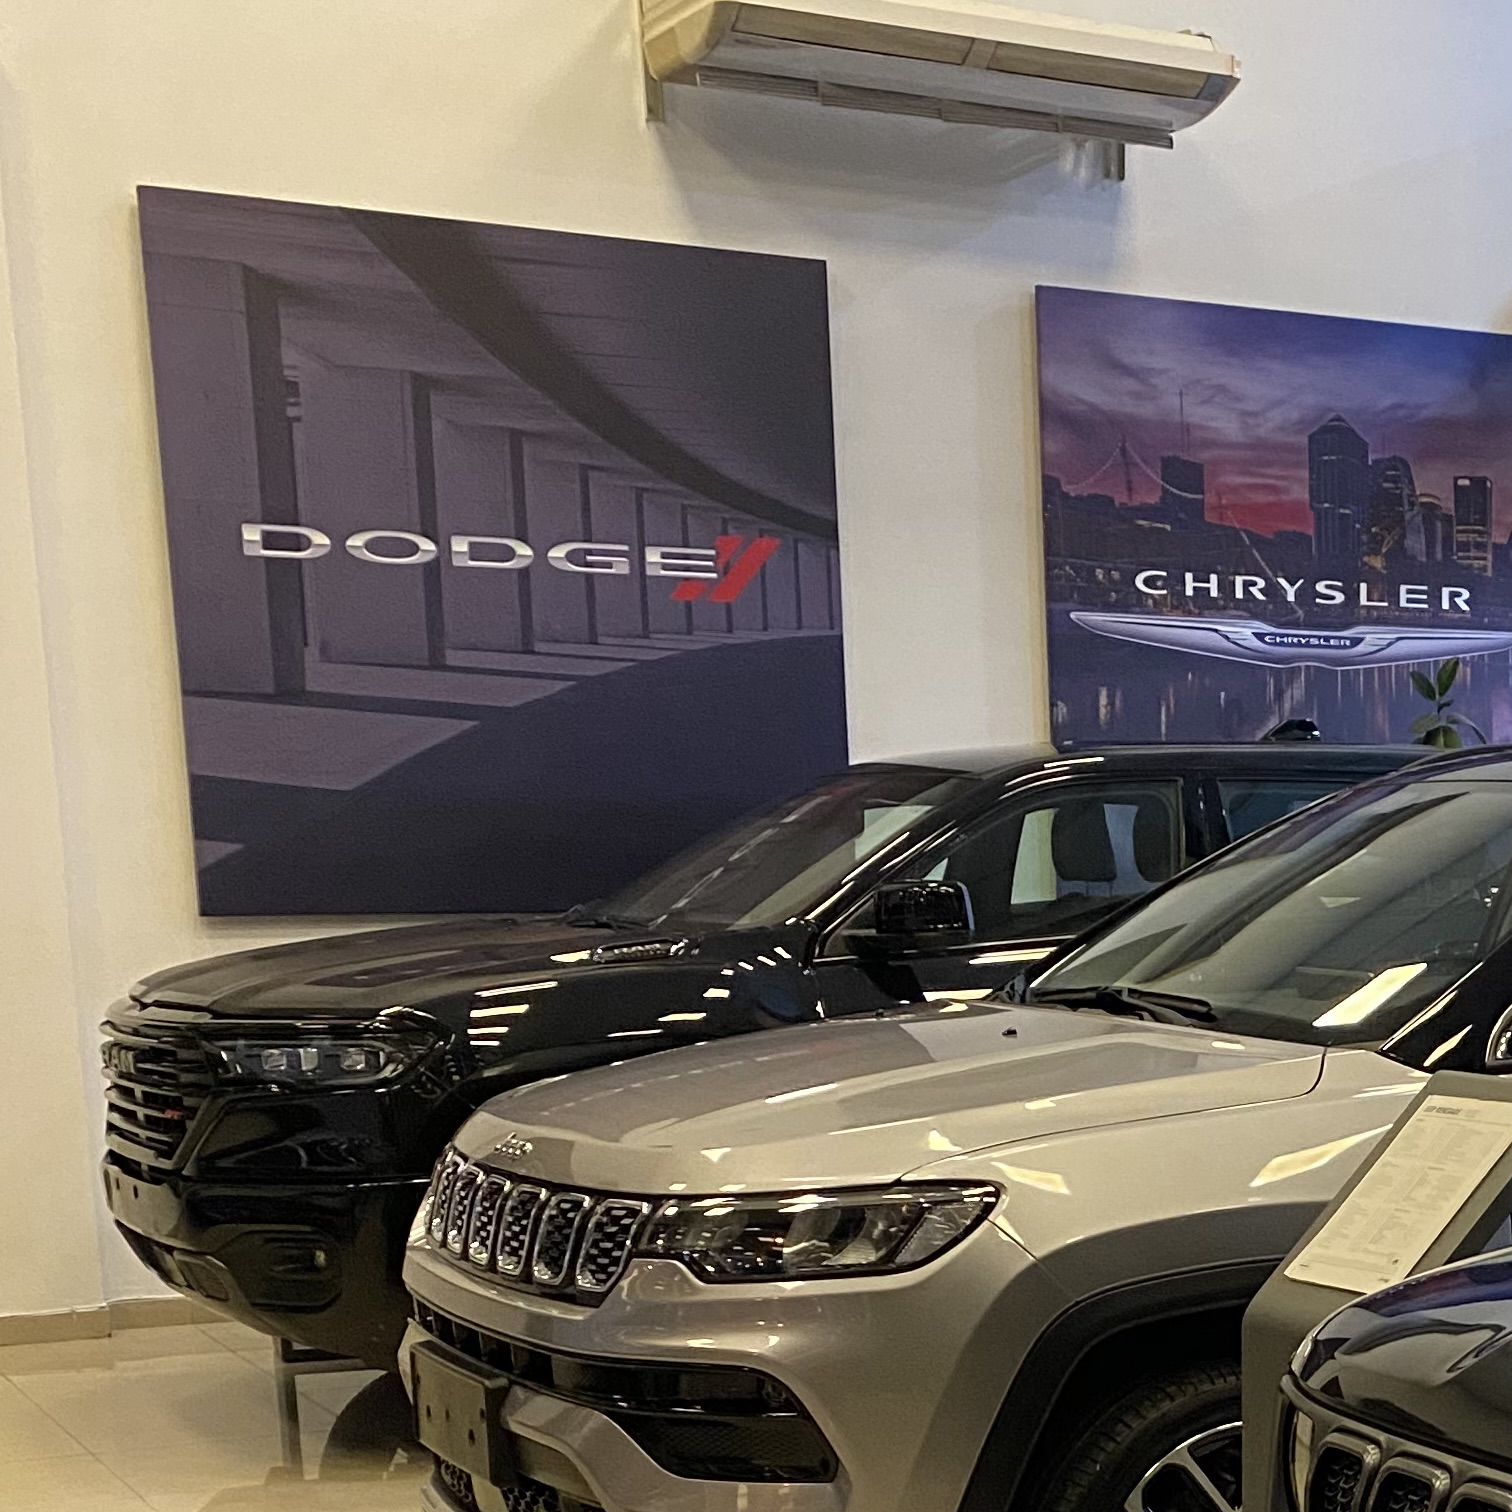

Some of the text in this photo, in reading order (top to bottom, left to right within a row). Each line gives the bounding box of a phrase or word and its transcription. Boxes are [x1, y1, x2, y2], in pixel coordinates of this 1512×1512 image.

[240, 522, 719, 579] DODGE
[1133, 568, 1473, 613] CHRYSLER
[1263, 634, 1353, 648] CHRYSLER
